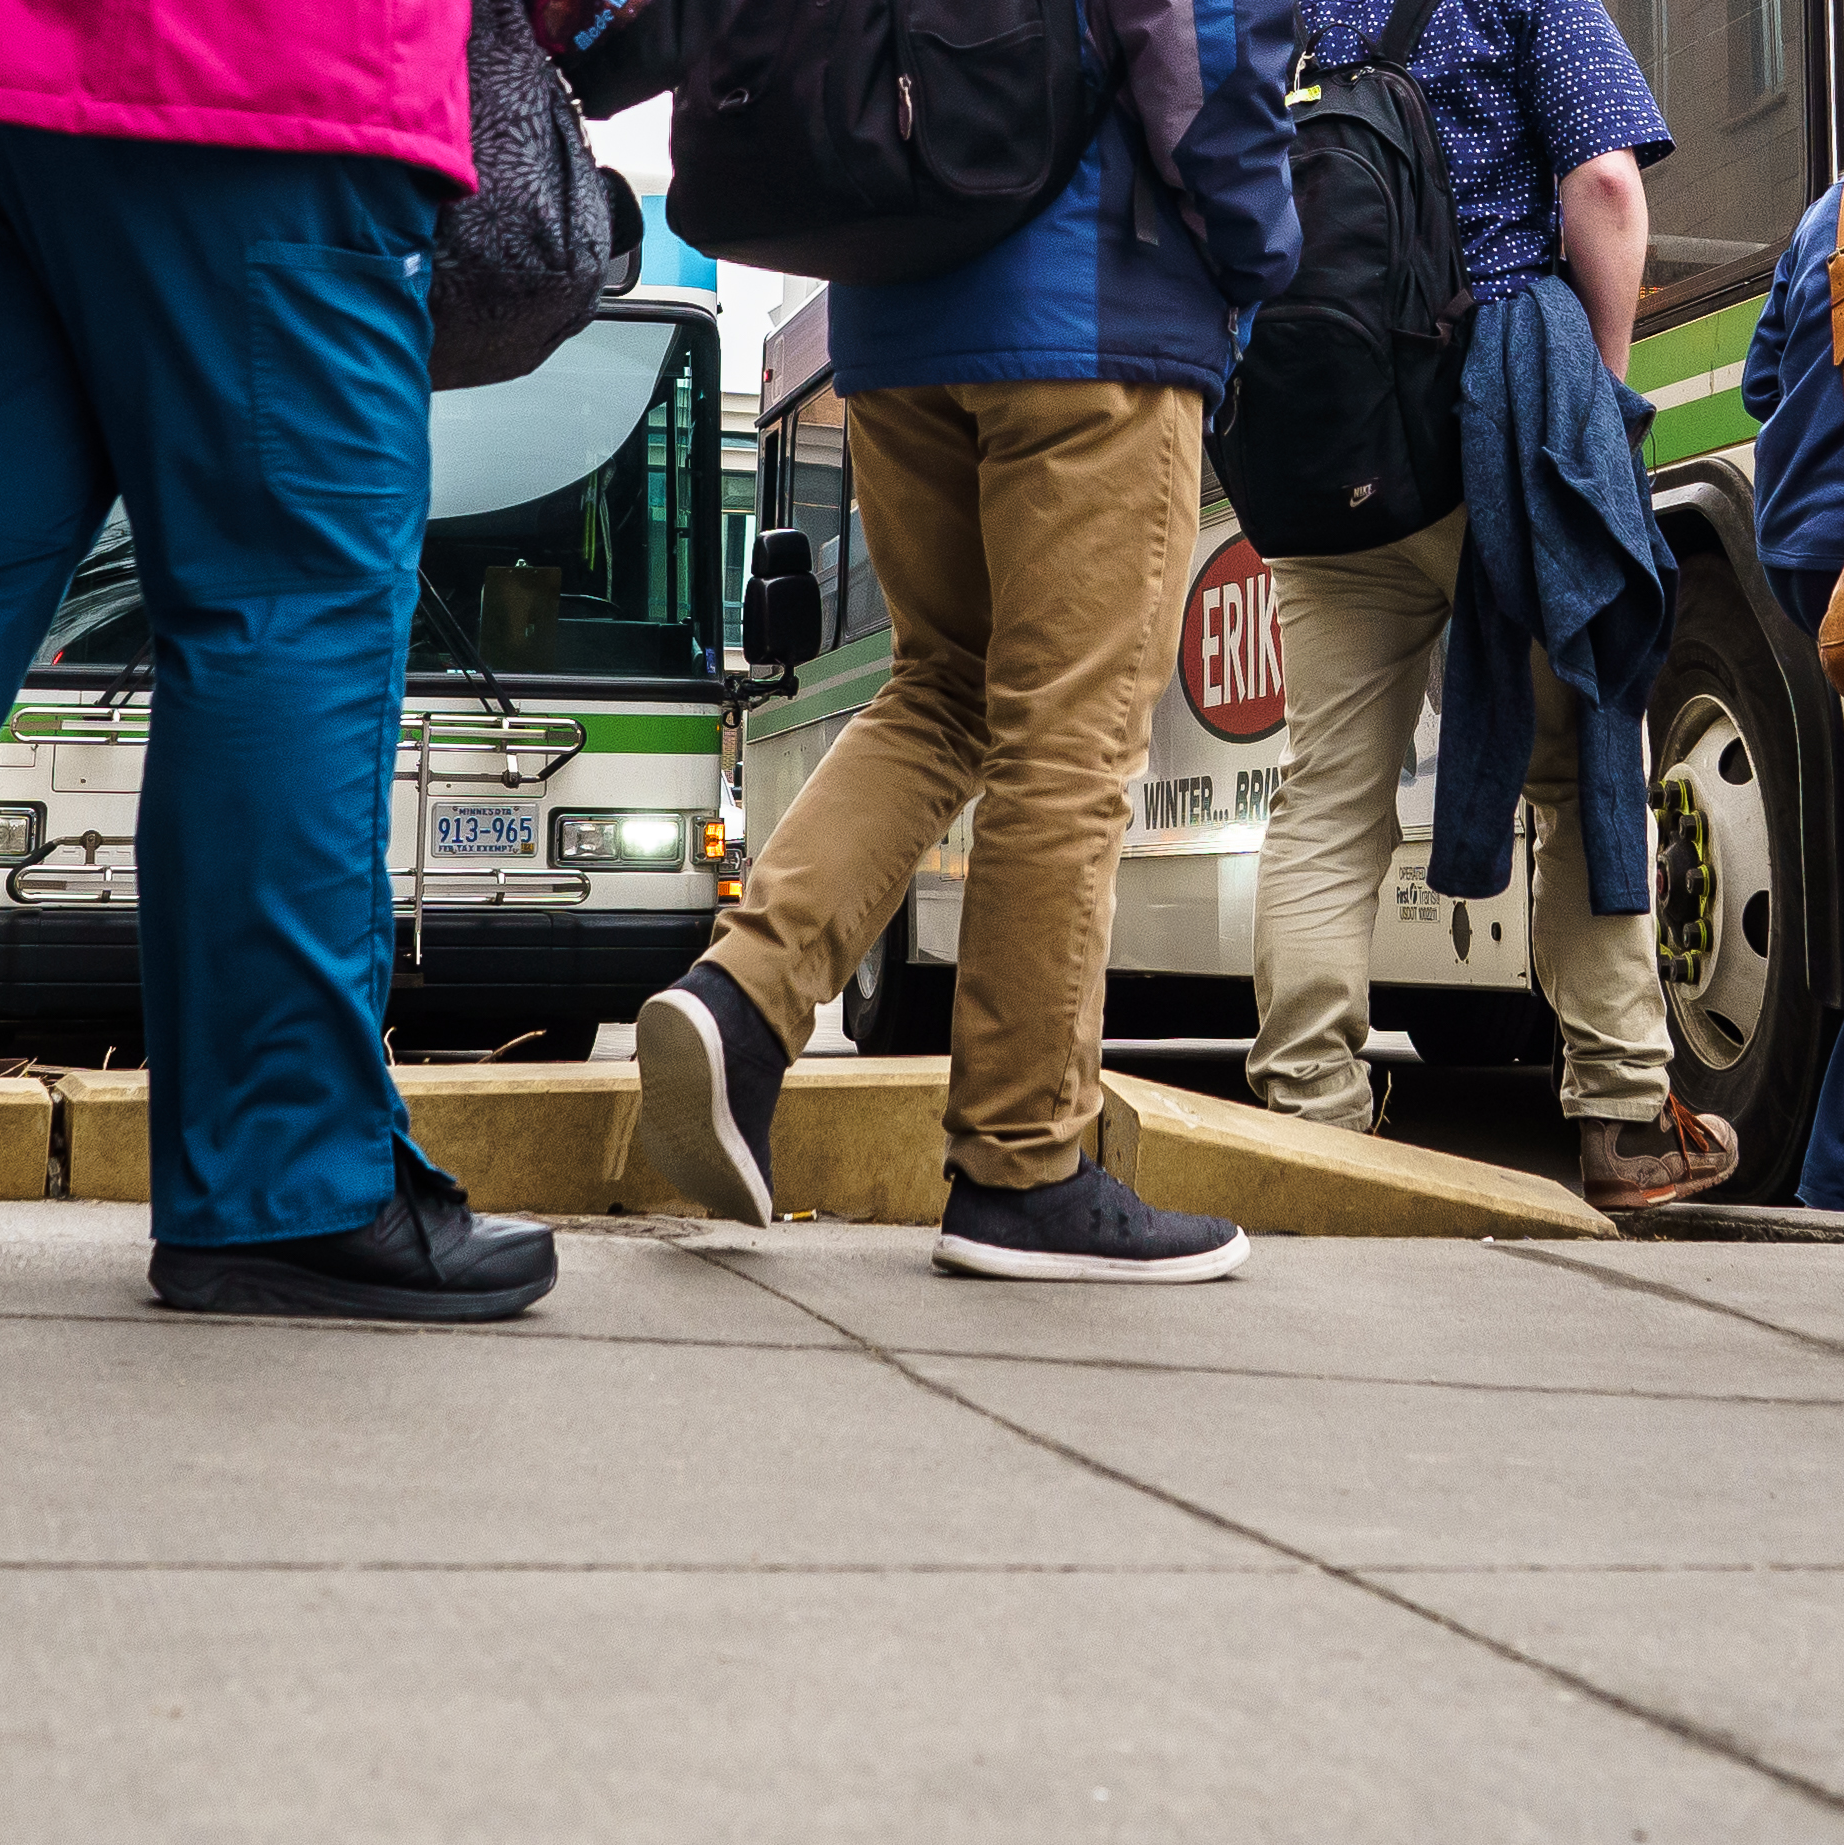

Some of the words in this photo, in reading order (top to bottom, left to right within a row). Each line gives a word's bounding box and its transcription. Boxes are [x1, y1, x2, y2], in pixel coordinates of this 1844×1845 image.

[458, 807, 512, 816] MINNESOTA
[438, 816, 533, 843] 913-965
[458, 844, 474, 853] TAX
[476, 844, 514, 853] EXEMPT
